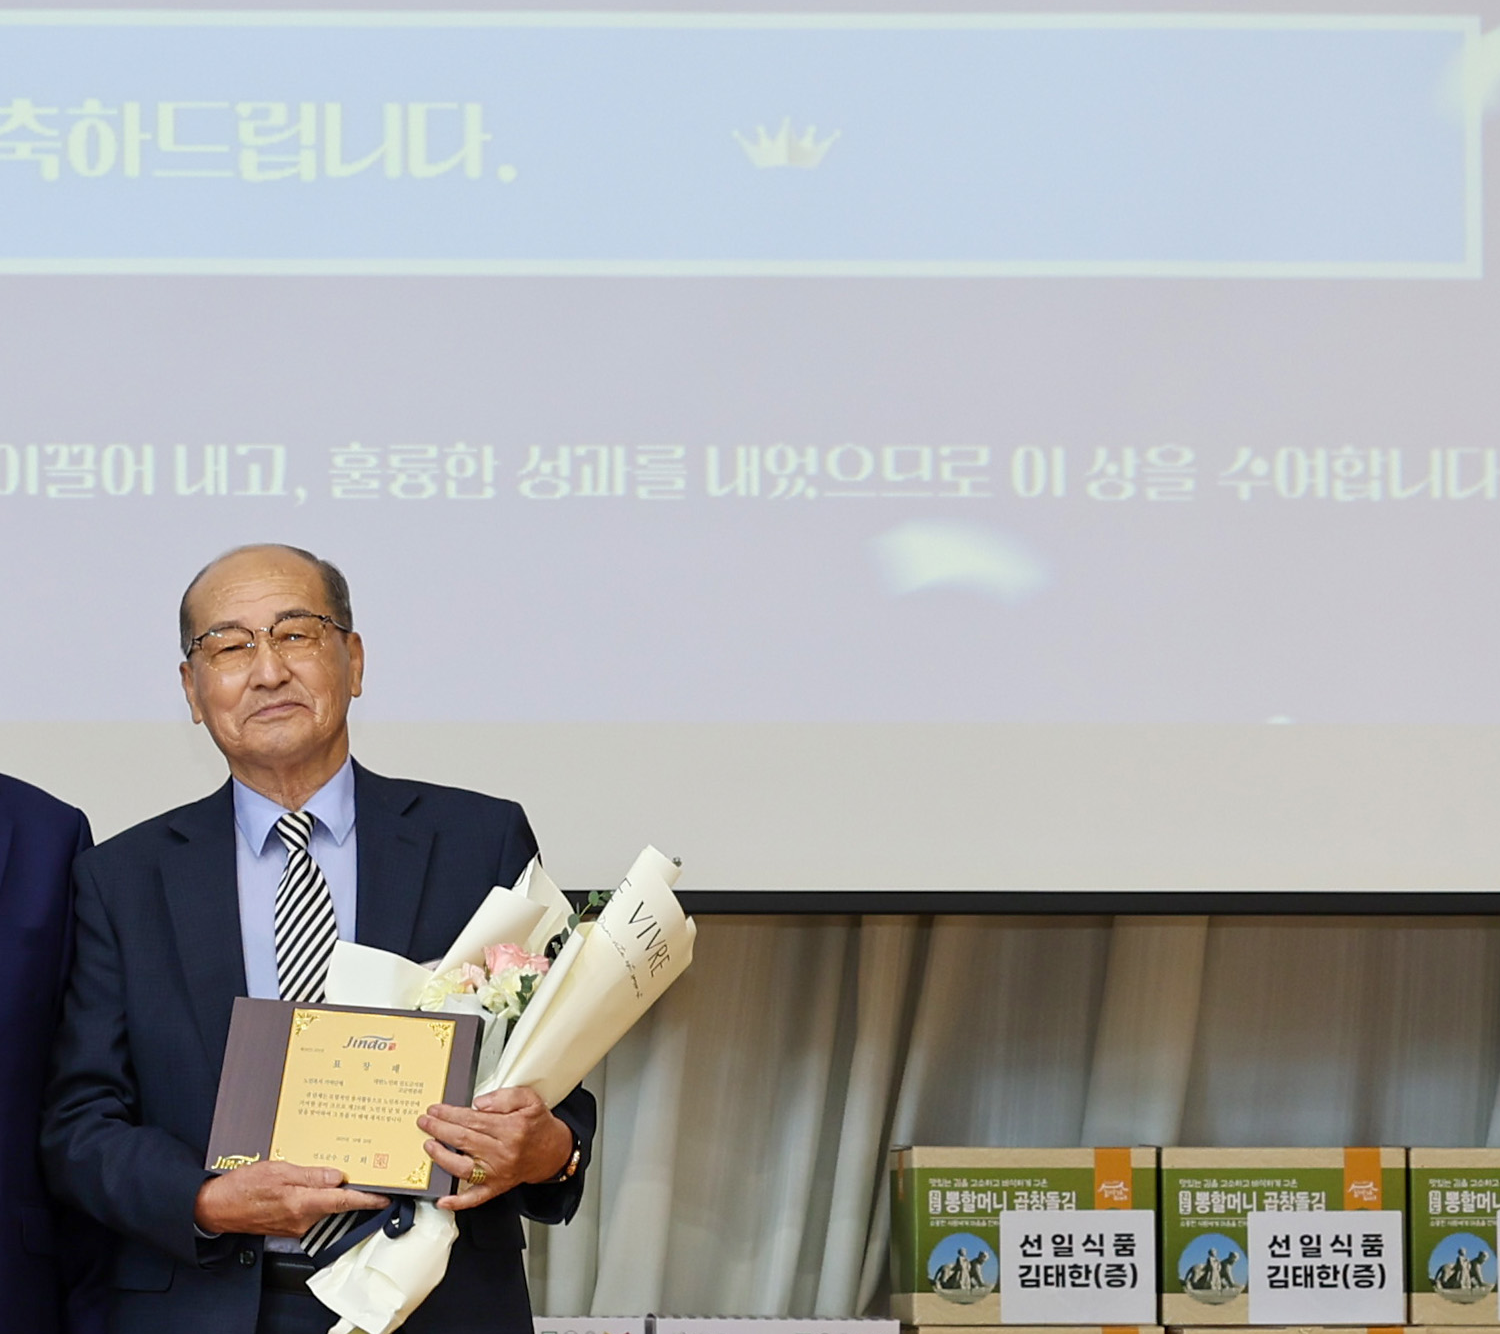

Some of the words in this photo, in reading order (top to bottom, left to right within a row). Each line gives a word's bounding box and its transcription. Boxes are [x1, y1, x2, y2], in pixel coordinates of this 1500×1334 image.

[174, 443, 306, 505] 내고,
[330, 442, 495, 499] 훌륭한
[517, 444, 686, 499] 성과를
[1009, 445, 1064, 497] 이
[1084, 444, 1197, 501] 상을
[628, 900, 670, 978] VIVRE
[342, 1036, 388, 1052] Jindo
[945, 1190, 1007, 1213] 뽕할머니
[1013, 1190, 1077, 1211] 곱창돌김
[1019, 1263, 1137, 1288] 김태한(증)
[1267, 1264, 1385, 1289] 김태한(증)
